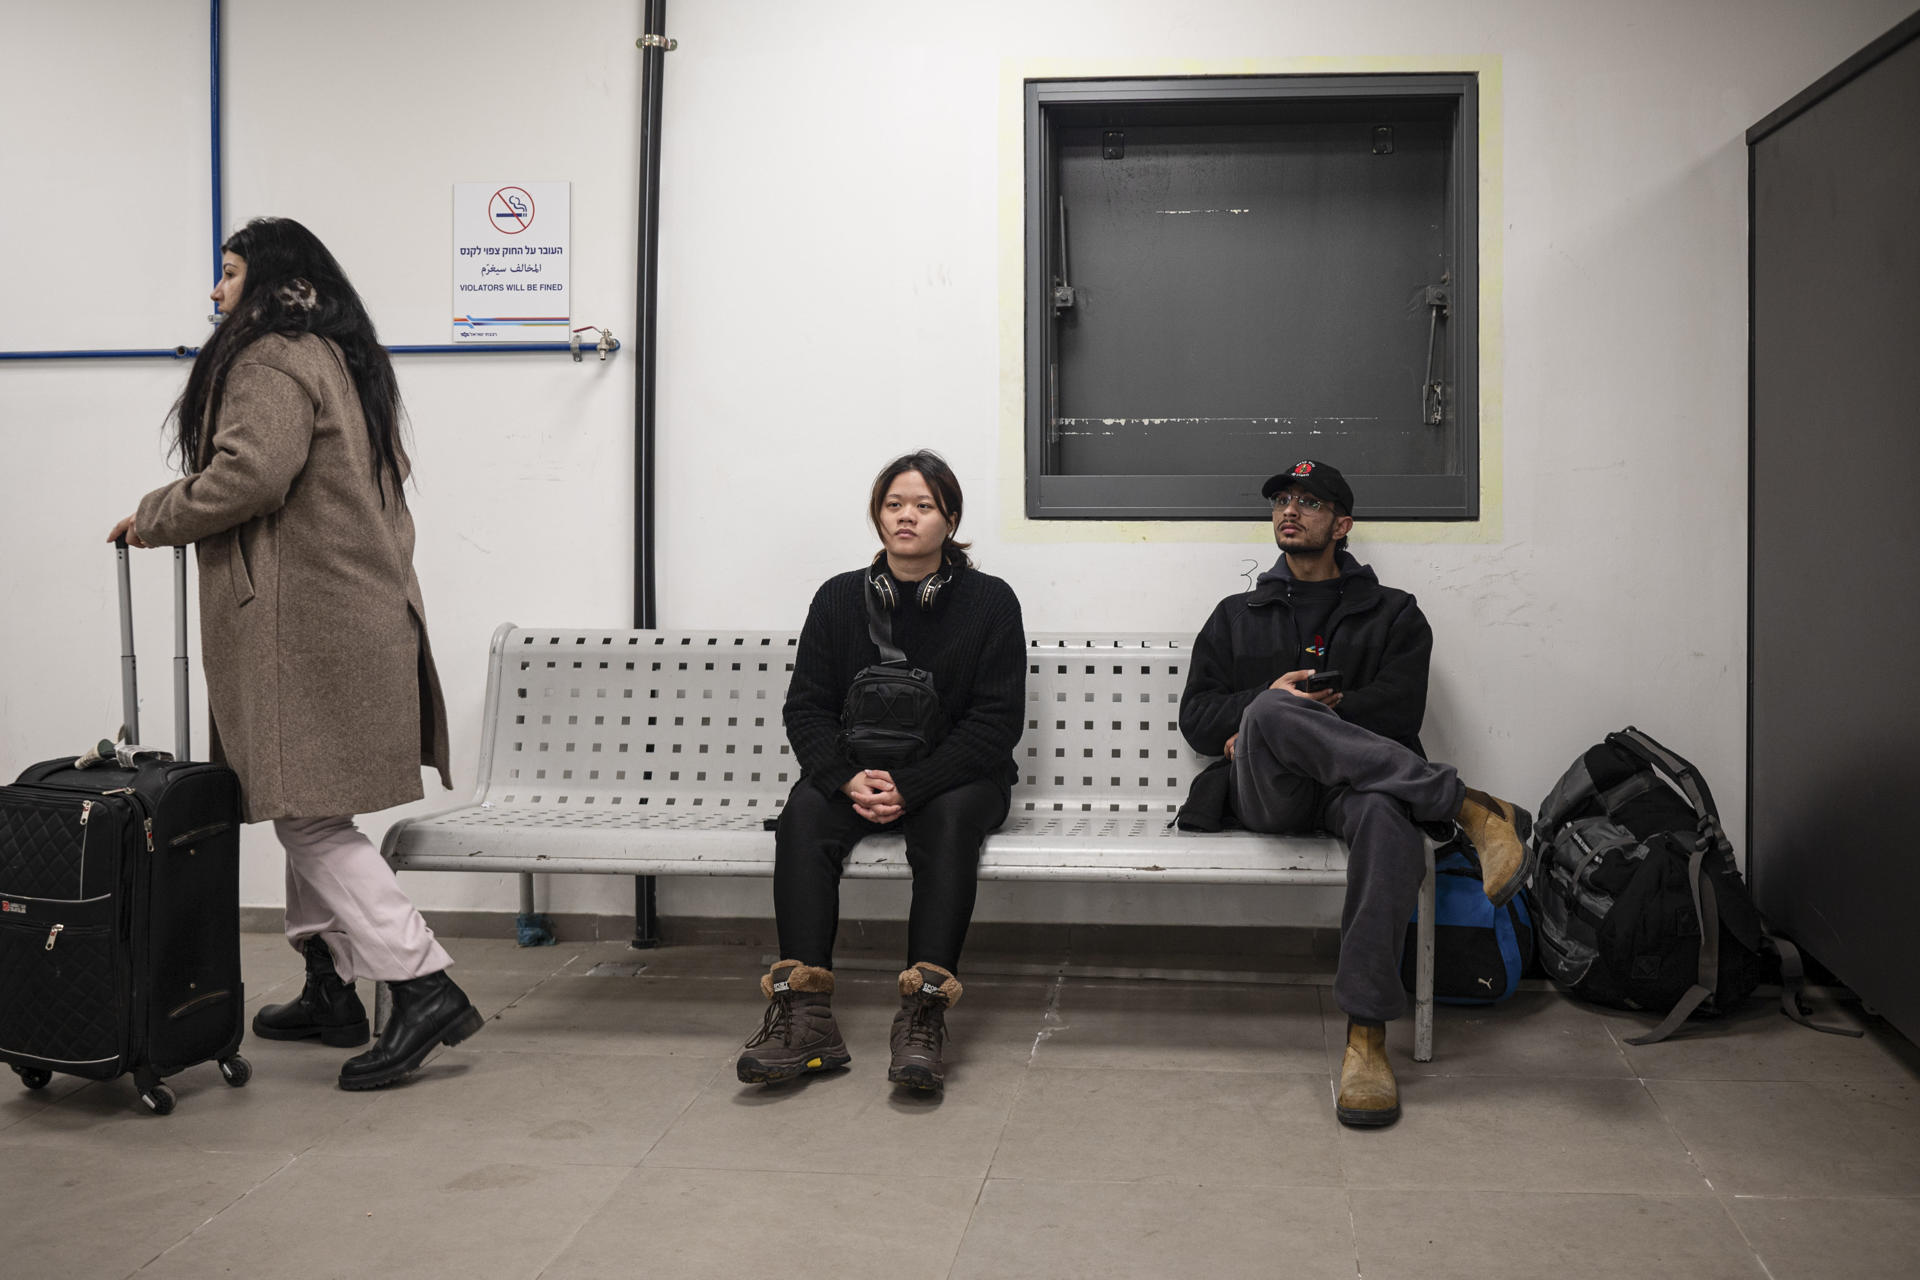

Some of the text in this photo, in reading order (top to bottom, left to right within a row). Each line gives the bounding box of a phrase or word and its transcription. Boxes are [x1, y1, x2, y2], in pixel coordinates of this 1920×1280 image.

[460, 245, 563, 257] העובר על החוק צפוי לקנס
[510, 263, 542, 273] المخالف
